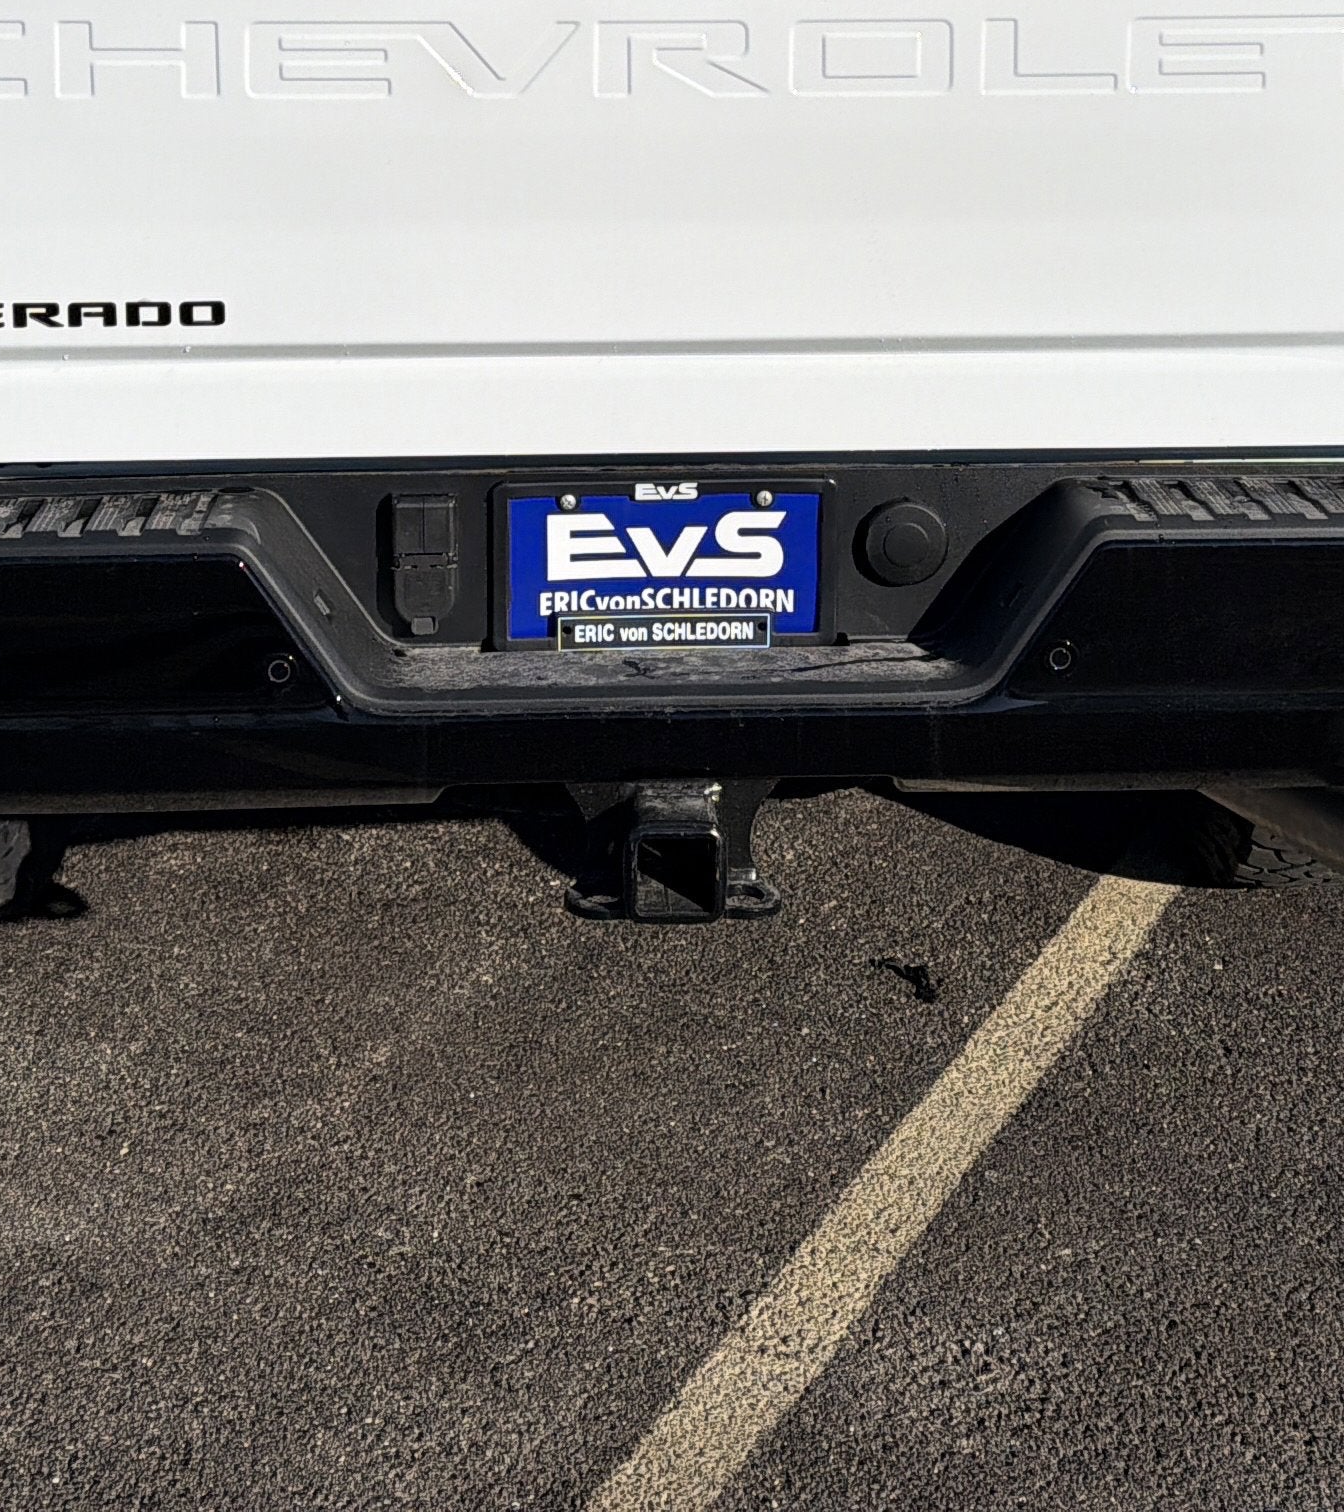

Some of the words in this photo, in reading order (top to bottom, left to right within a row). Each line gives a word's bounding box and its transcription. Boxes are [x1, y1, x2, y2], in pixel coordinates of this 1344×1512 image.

[574, 624, 615, 643] ERIC
[619, 624, 648, 641] von
[652, 621, 754, 641] SCHLEDORN
